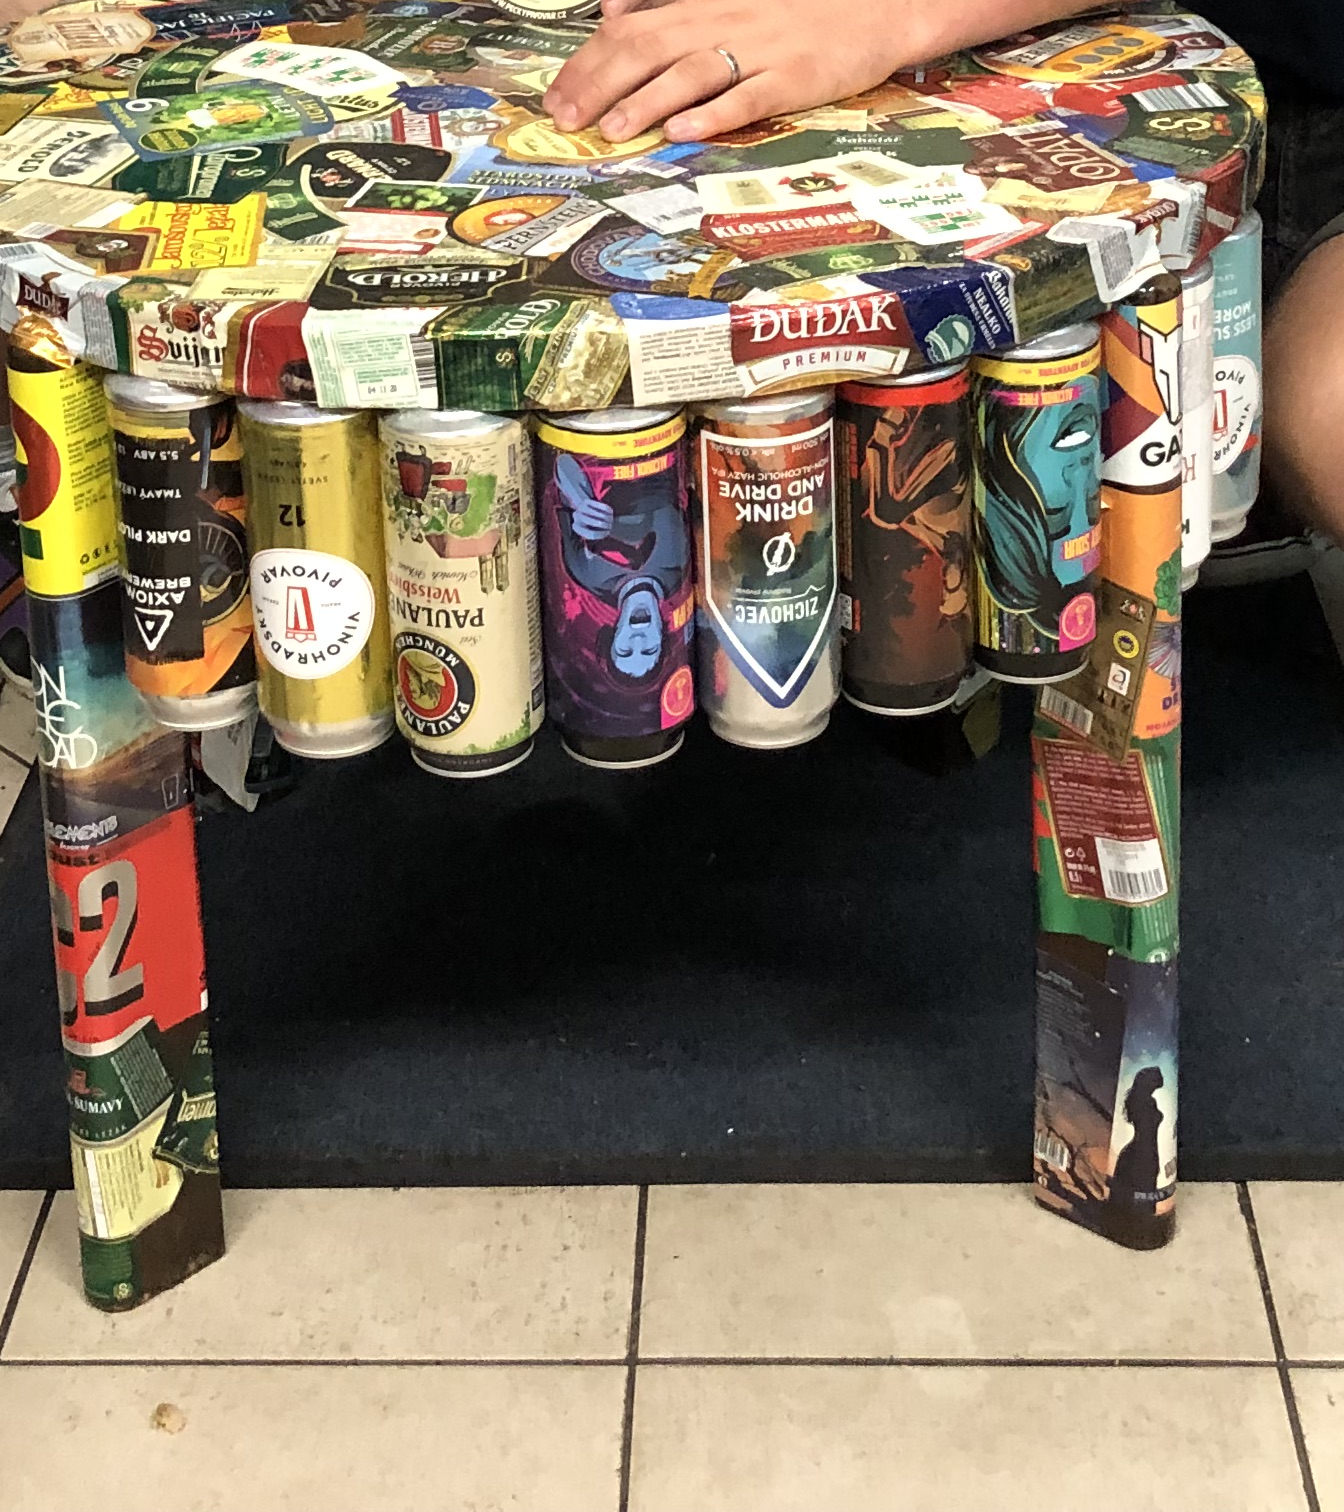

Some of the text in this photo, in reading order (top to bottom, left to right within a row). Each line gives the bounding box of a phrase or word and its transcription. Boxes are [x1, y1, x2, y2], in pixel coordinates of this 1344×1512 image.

[189, 8, 275, 28] PACIFIC
[325, 149, 392, 180] ERNARD
[1013, 132, 1121, 180] OPAT
[346, 266, 508, 287] HEROLD
[972, 289, 1002, 335] NEALKO
[1214, 301, 1251, 323] MORE
[783, 350, 867, 369] PREMIUM
[1215, 369, 1246, 385] PIVO
[1017, 387, 1074, 406] ALCOHOL FREE
[133, 448, 156, 460] ABV
[613, 455, 668, 479] ALCOHOL FREE
[728, 470, 755, 480] HAZY
[757, 456, 829, 482] NON-ALCOHOLIC
[139, 486, 182, 500] TMAVÝ
[718, 469, 825, 501] AND DRIVE
[278, 504, 306, 528] 12
[735, 494, 813, 522] DRINK
[118, 521, 191, 544] DARK PILO
[260, 564, 343, 589] PIVOVAR
[124, 583, 185, 606] AXIOM
[388, 573, 461, 605] Weissbie
[388, 594, 485, 629] PAULANE
[735, 595, 819, 624] ZICHOVEC
[37, 727, 98, 770] OAD
